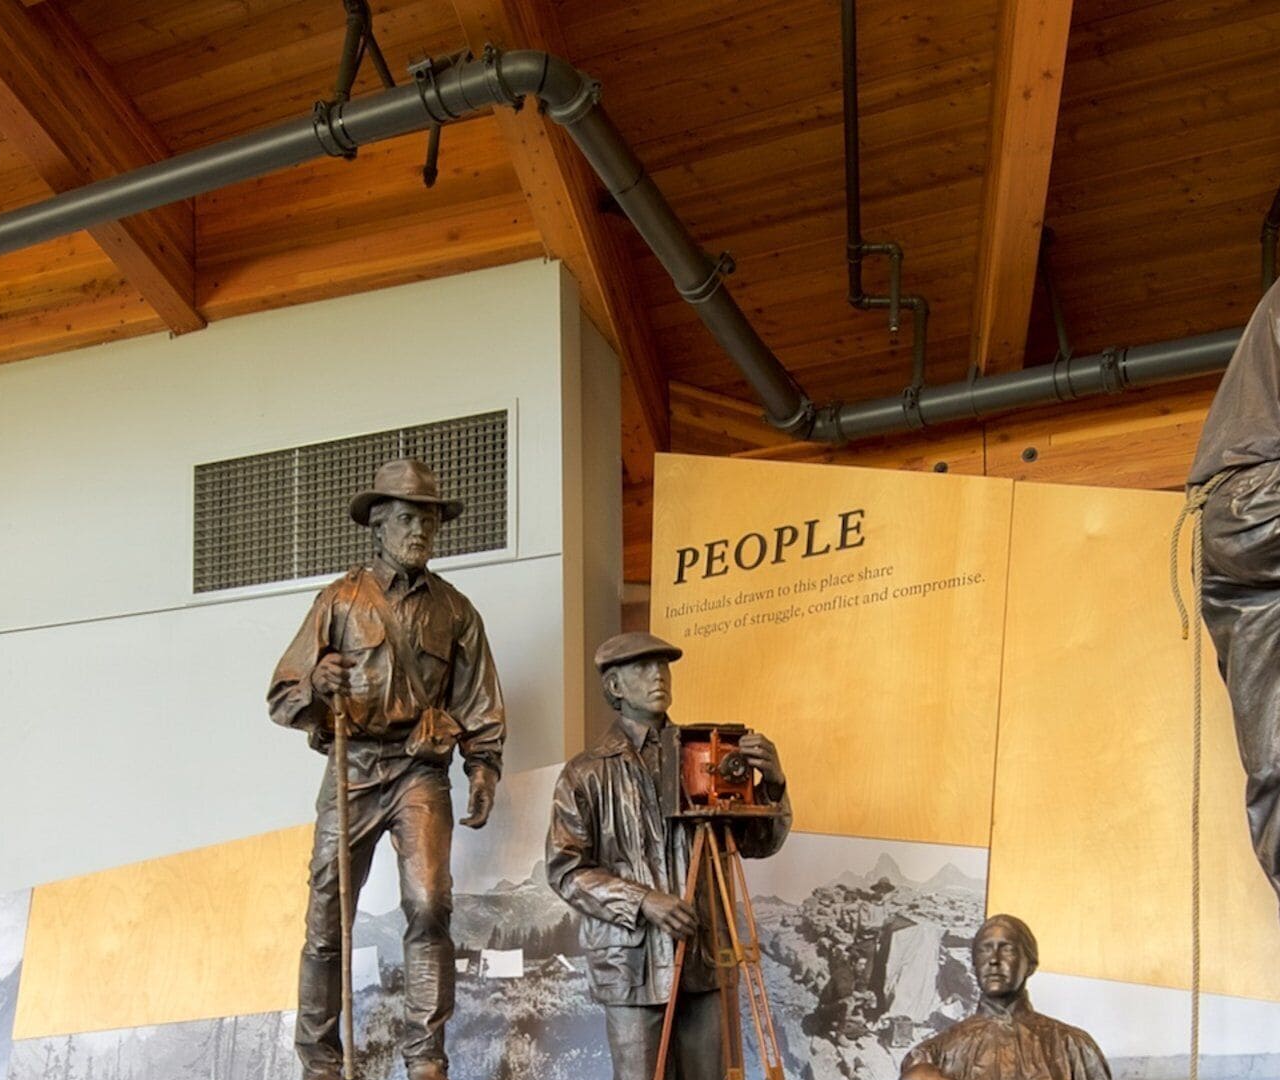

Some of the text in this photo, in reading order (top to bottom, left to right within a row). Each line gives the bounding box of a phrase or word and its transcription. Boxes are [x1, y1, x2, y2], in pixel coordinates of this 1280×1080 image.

[673, 509, 866, 586] PEOPLE
[665, 566, 894, 619] Individuals drawn to this place share
[683, 573, 985, 639] a legacy of struggle, conflict and compromise.
